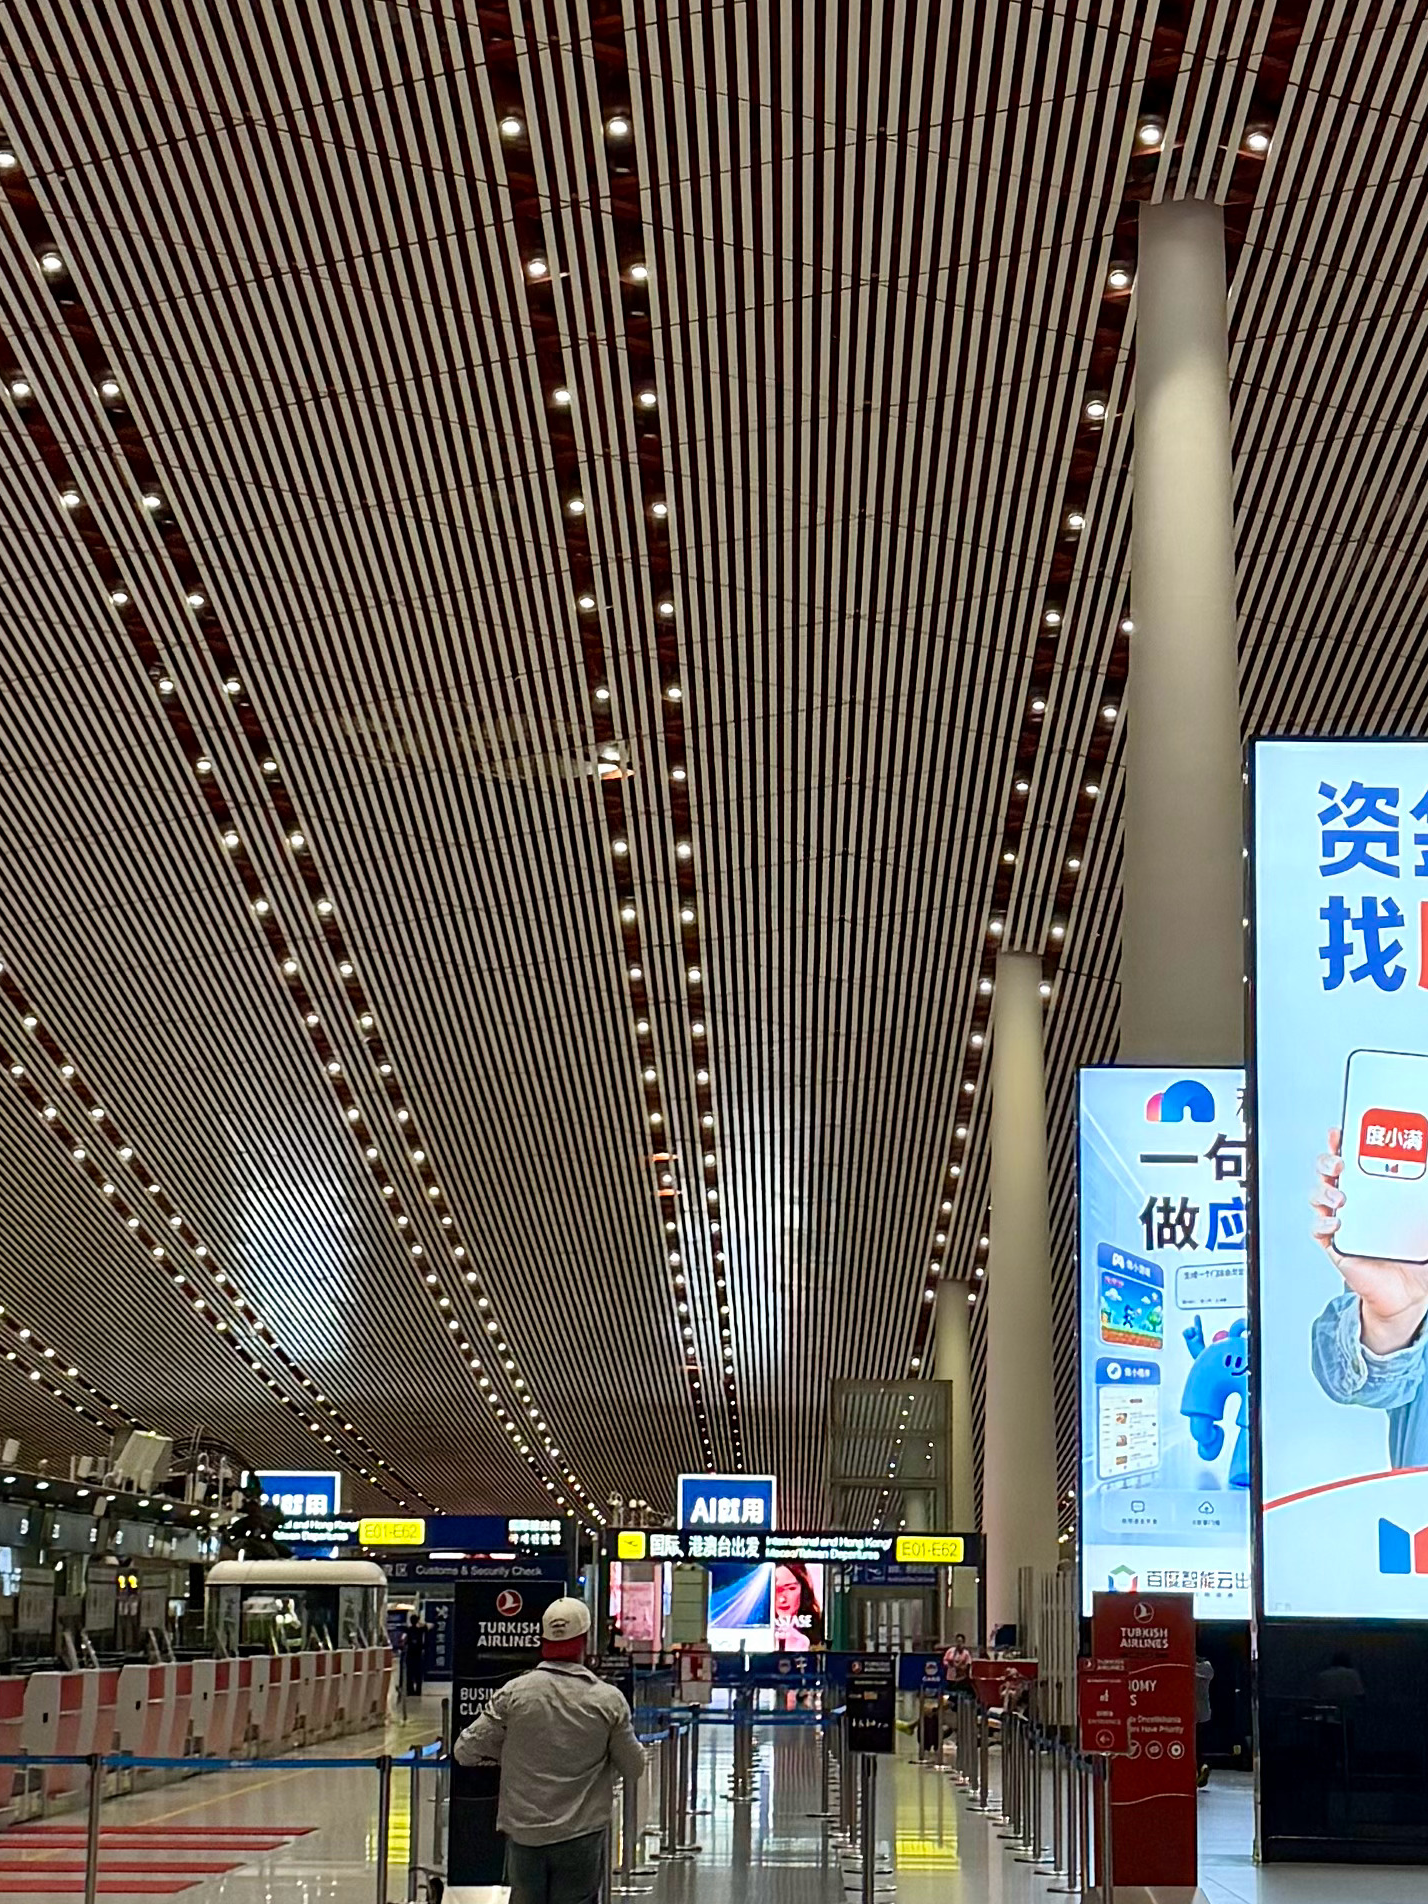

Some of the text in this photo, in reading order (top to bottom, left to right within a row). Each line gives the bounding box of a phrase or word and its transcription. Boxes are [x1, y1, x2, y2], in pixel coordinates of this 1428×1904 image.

[1365, 1125, 1424, 1152] 度小满
[365, 1524, 417, 1539] E01-E62
[820, 1537, 838, 1547] and
[839, 1537, 864, 1549] Hong
[902, 1541, 958, 1557] E01-E62
[415, 1564, 459, 1576] Customs
[471, 1564, 510, 1578] Security
[512, 1564, 542, 1576] Check
[479, 1621, 541, 1634] TURKISH
[1120, 1627, 1169, 1638] TURKISH
[477, 1634, 541, 1648] AIRLINES
[1120, 1638, 1170, 1649] AIRLINES
